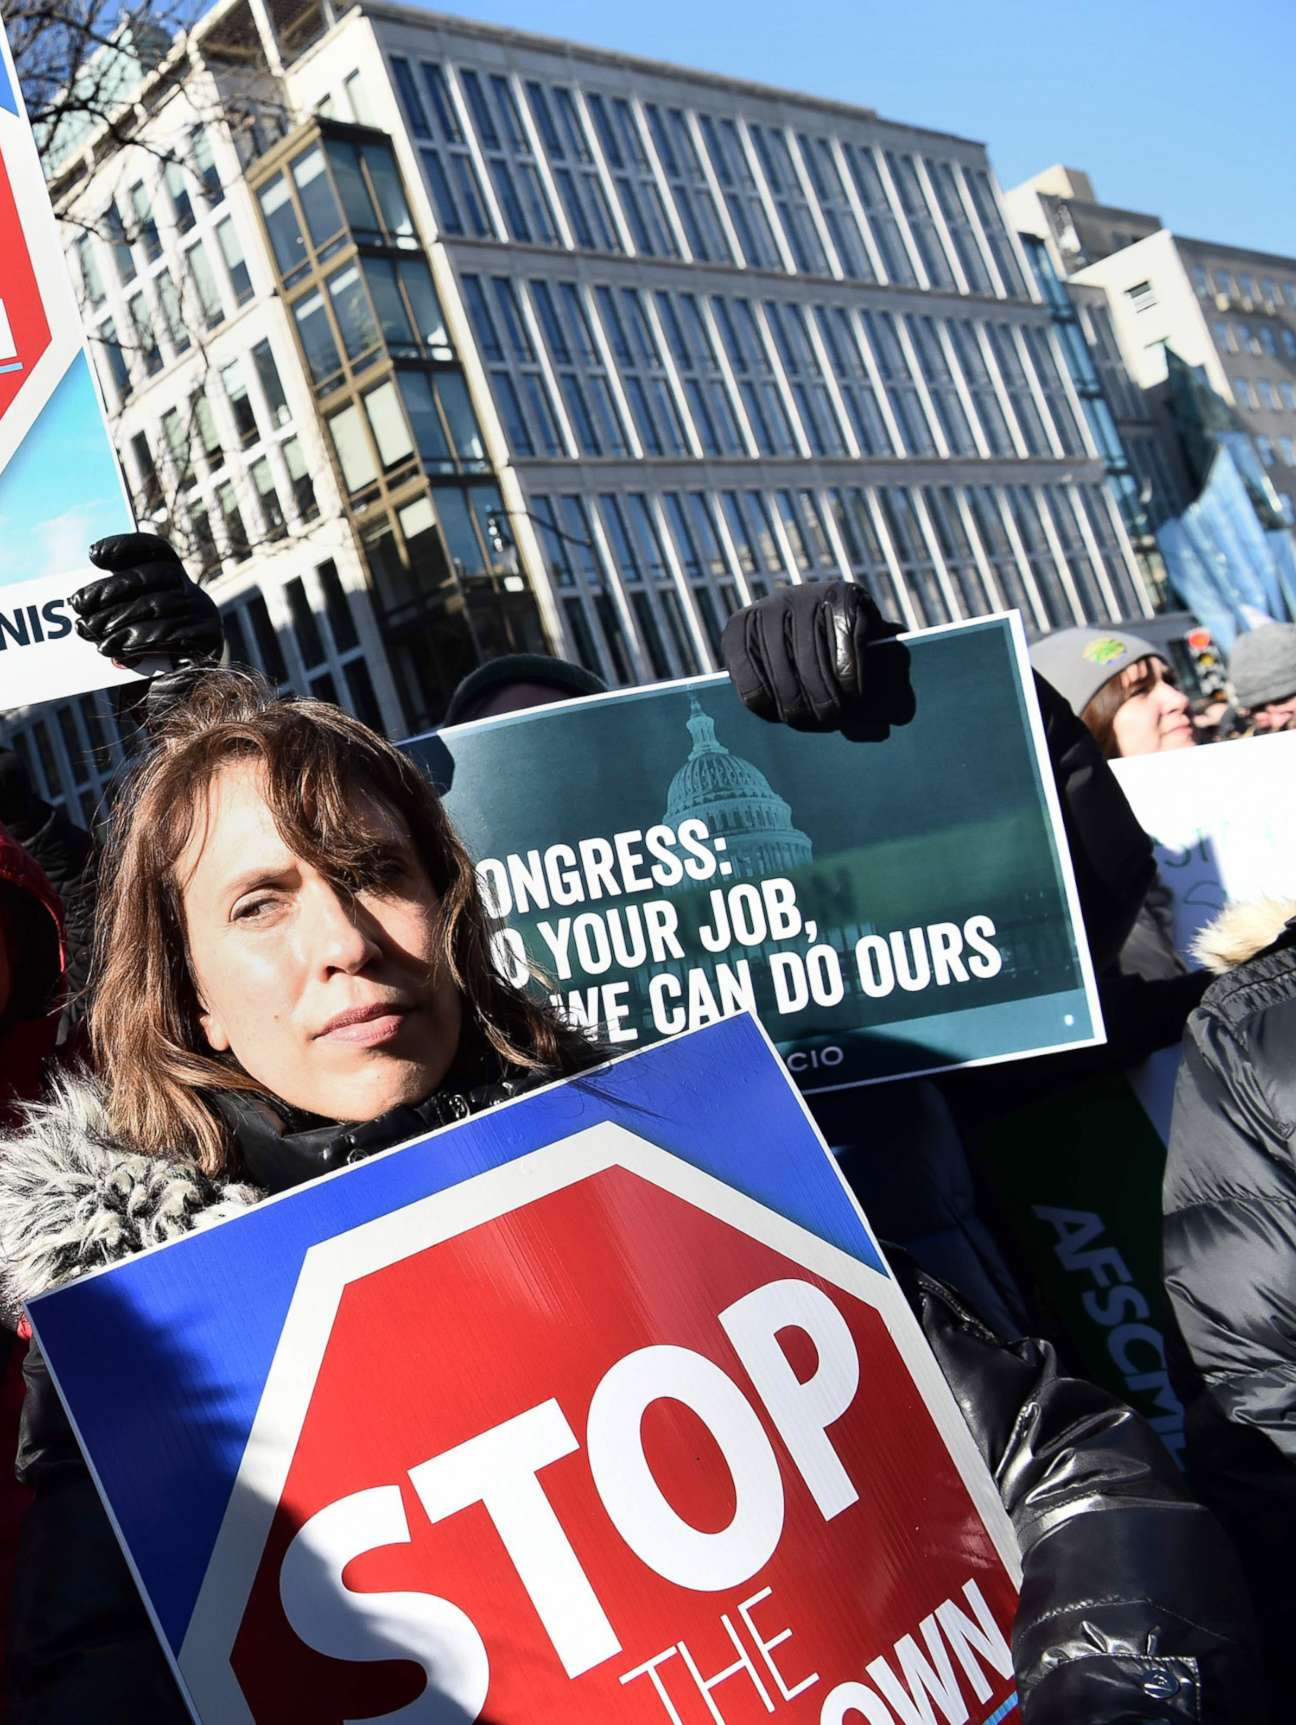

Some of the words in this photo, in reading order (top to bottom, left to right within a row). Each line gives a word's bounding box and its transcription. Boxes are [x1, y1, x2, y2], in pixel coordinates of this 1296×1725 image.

[476, 818, 732, 919] ONGRESS:
[490, 928, 530, 989] O
[537, 900, 685, 980] YOUR
[698, 878, 817, 952] JOB,
[549, 981, 638, 1043] WE
[650, 958, 757, 1036] CAN
[768, 944, 844, 1014] DO
[855, 914, 1002, 997] OURS
[280, 1279, 861, 1725] STOP
[619, 1586, 820, 1725] THE
[819, 1578, 1015, 1725] OWN
